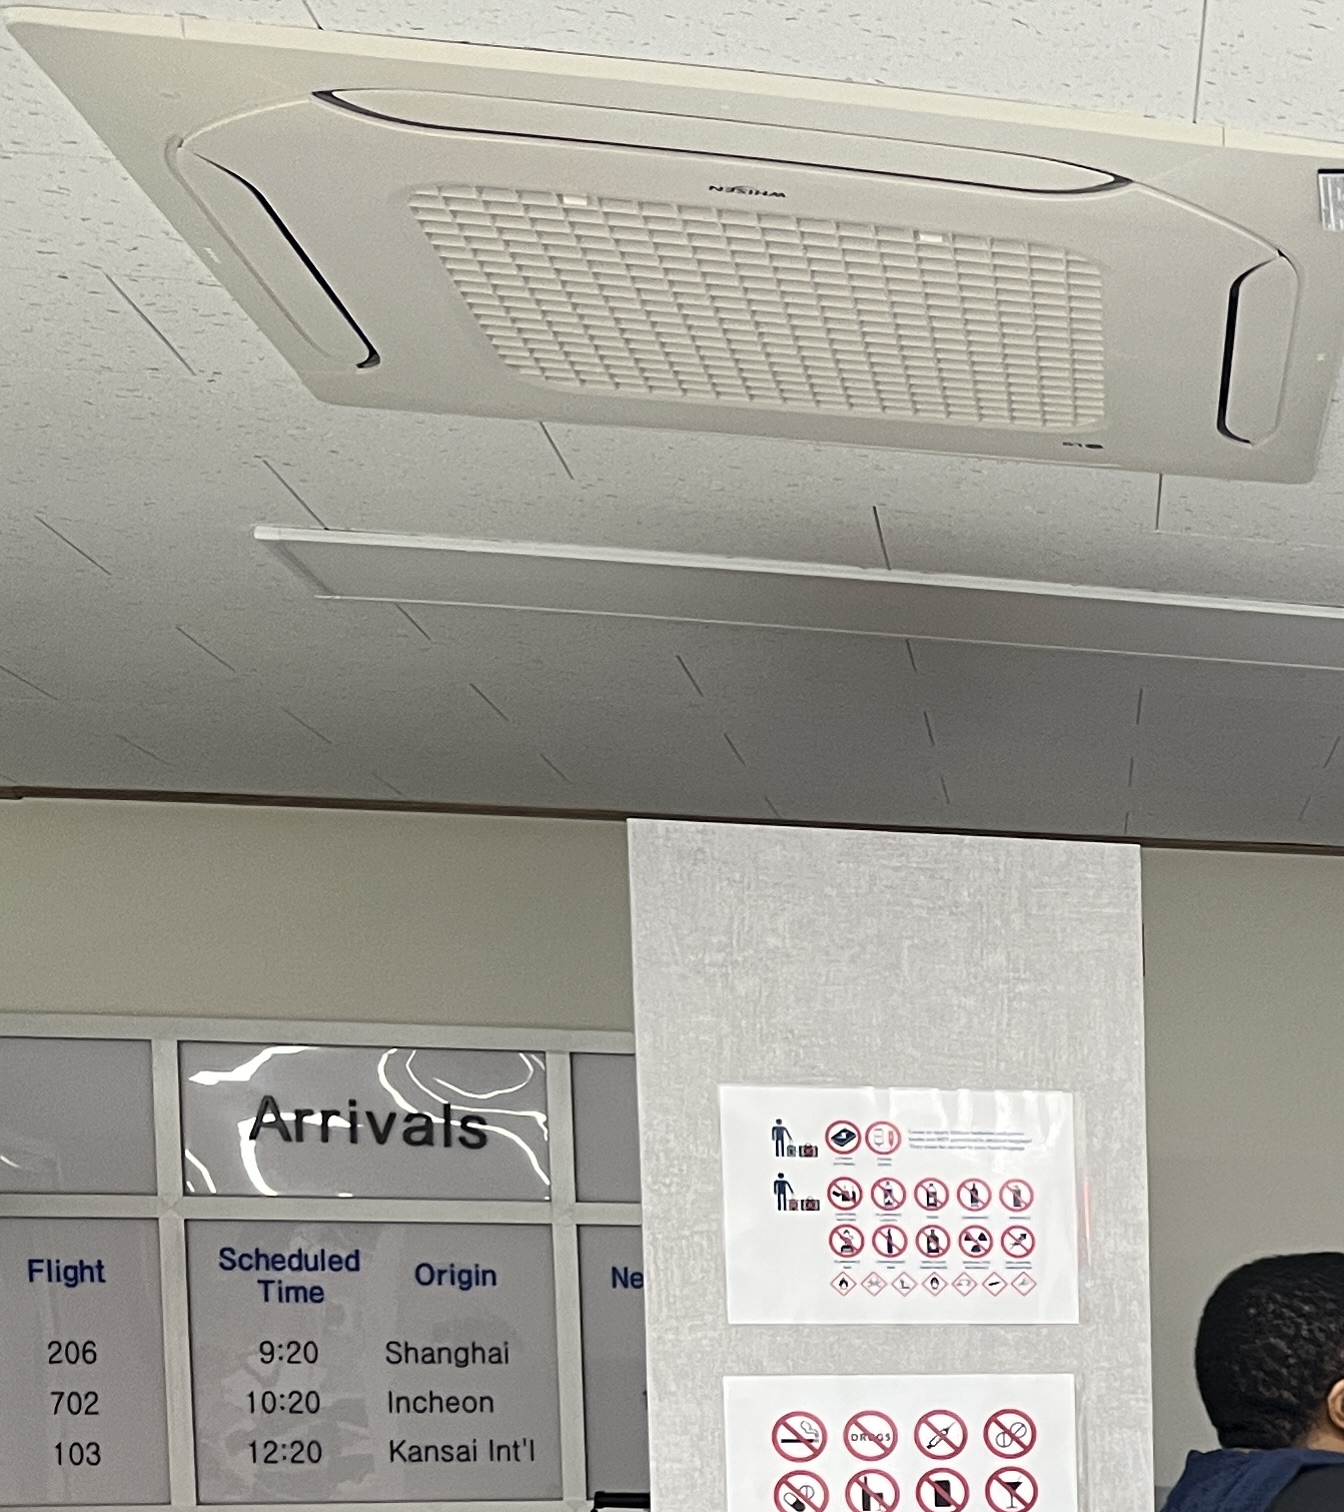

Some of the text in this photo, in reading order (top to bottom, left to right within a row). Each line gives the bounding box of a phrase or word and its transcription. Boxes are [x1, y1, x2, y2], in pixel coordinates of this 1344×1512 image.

[249, 1094, 488, 1149] Arrivals
[27, 1258, 106, 1288] Flight
[219, 1248, 360, 1274] Scheduled
[415, 1263, 497, 1290] Origin
[257, 1280, 325, 1304] Time
[47, 1341, 97, 1365] 206
[258, 1341, 319, 1365] 9:20
[386, 1341, 509, 1369] Shanghai
[51, 1391, 99, 1415] 702
[248, 1390, 321, 1414] 10:20
[387, 1391, 494, 1414] Incheon
[55, 1442, 101, 1466] 103
[249, 1440, 322, 1464] 12:20
[389, 1439, 535, 1463] Kansai Int'l
